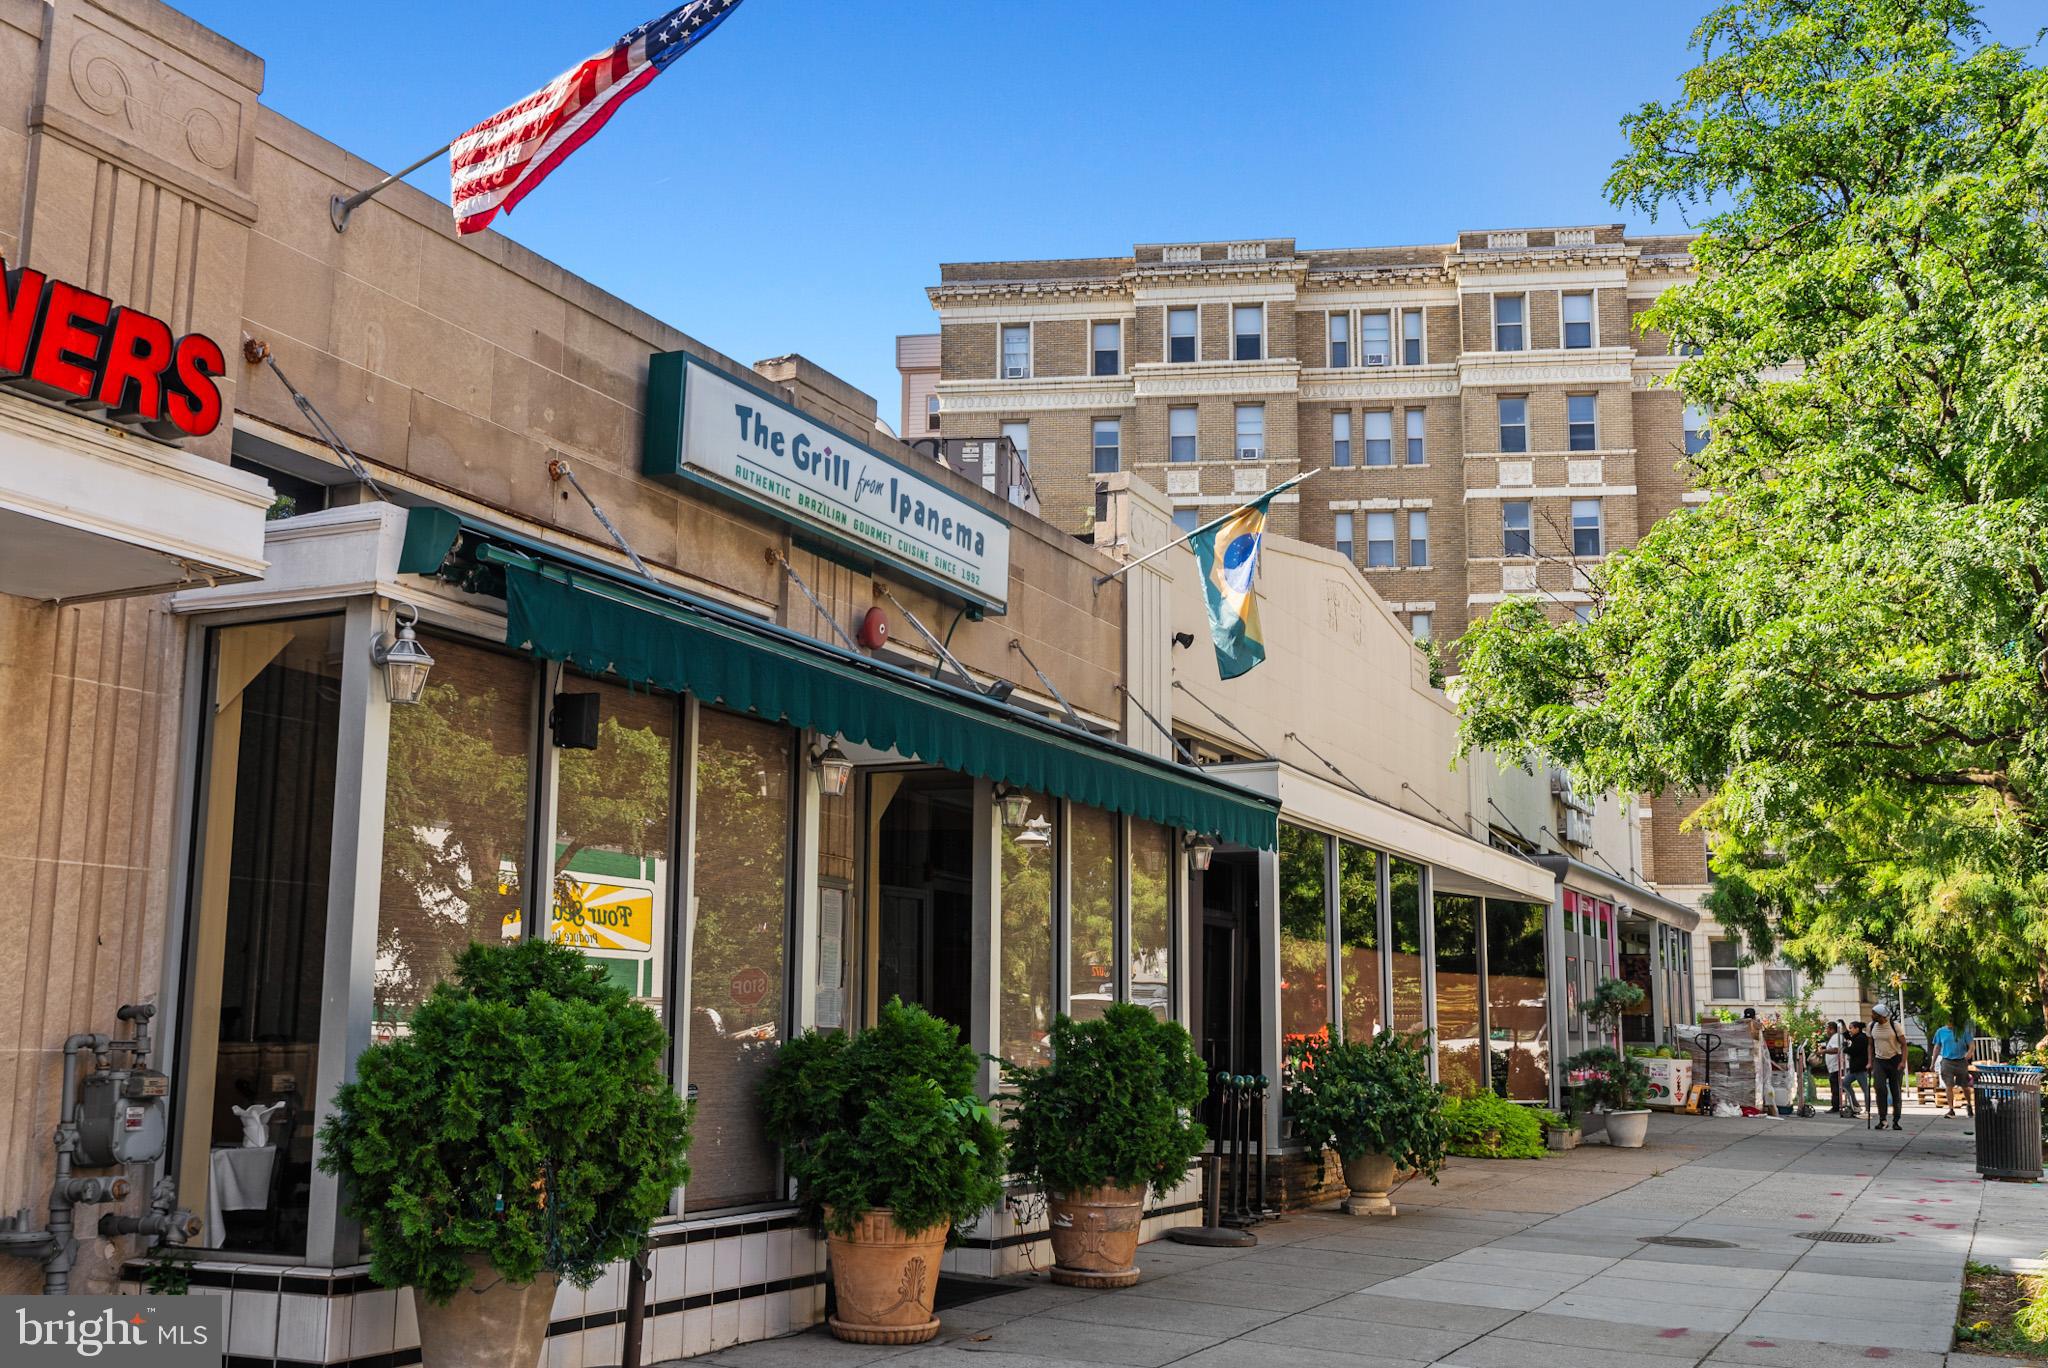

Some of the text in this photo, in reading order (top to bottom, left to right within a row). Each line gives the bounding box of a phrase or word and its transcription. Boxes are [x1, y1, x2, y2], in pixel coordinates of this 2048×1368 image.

[735, 404, 985, 557] The Grill from Ipanema
[735, 464, 980, 586] AUTHENTIC BRAZILIAN GOURMET CUISINE SINCE 1992
